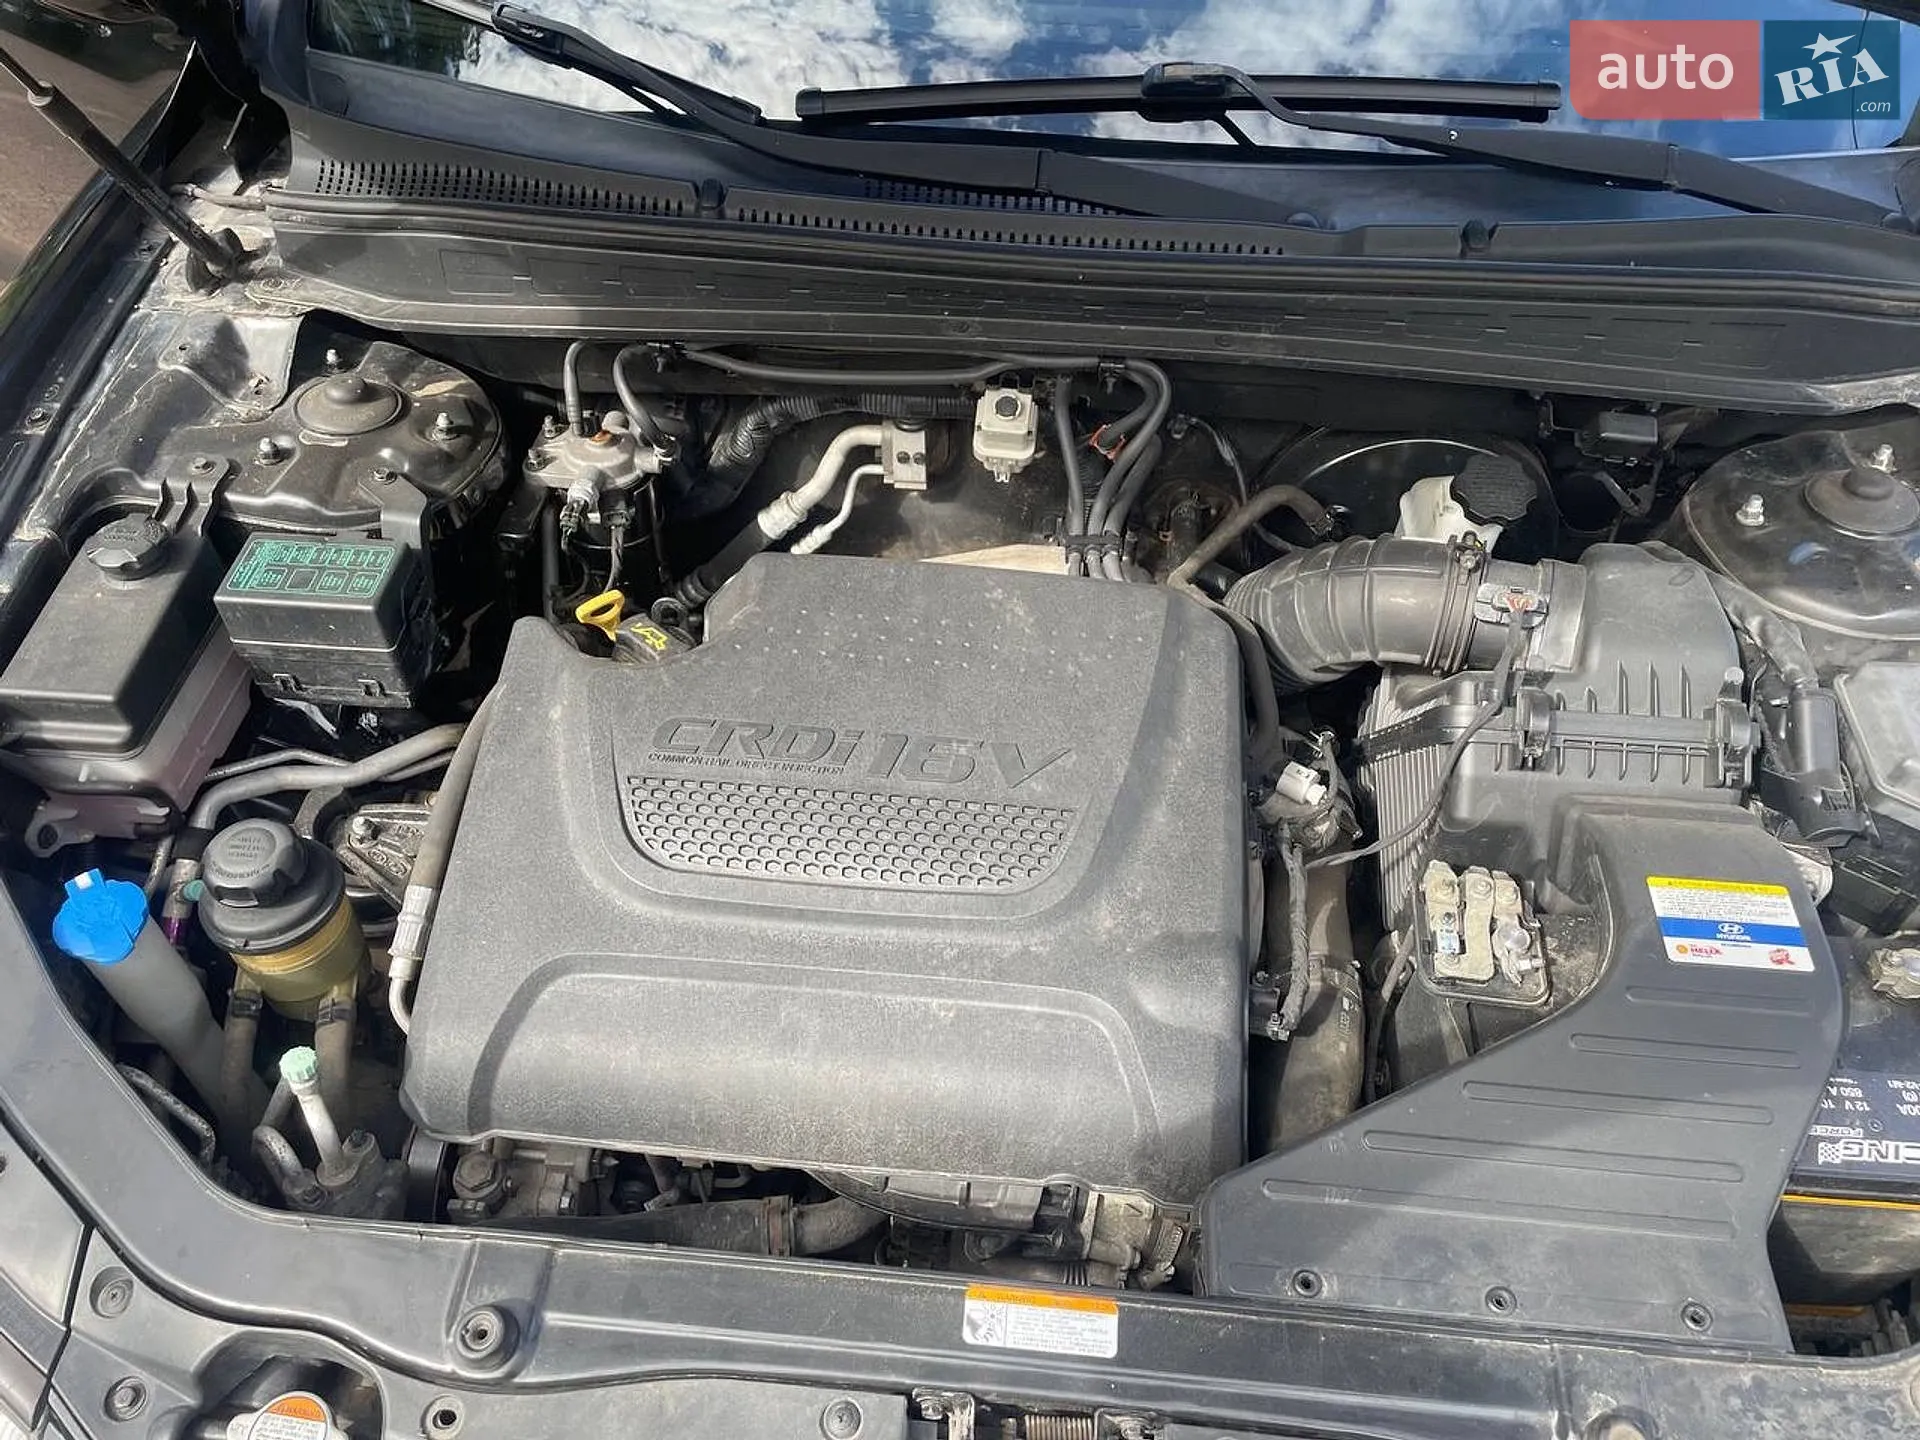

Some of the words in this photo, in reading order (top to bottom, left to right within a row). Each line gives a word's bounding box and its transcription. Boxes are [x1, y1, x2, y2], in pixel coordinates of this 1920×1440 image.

[648, 752, 703, 766] COMMON
[650, 716, 866, 767] CRDi
[867, 733, 1073, 789] 16V
